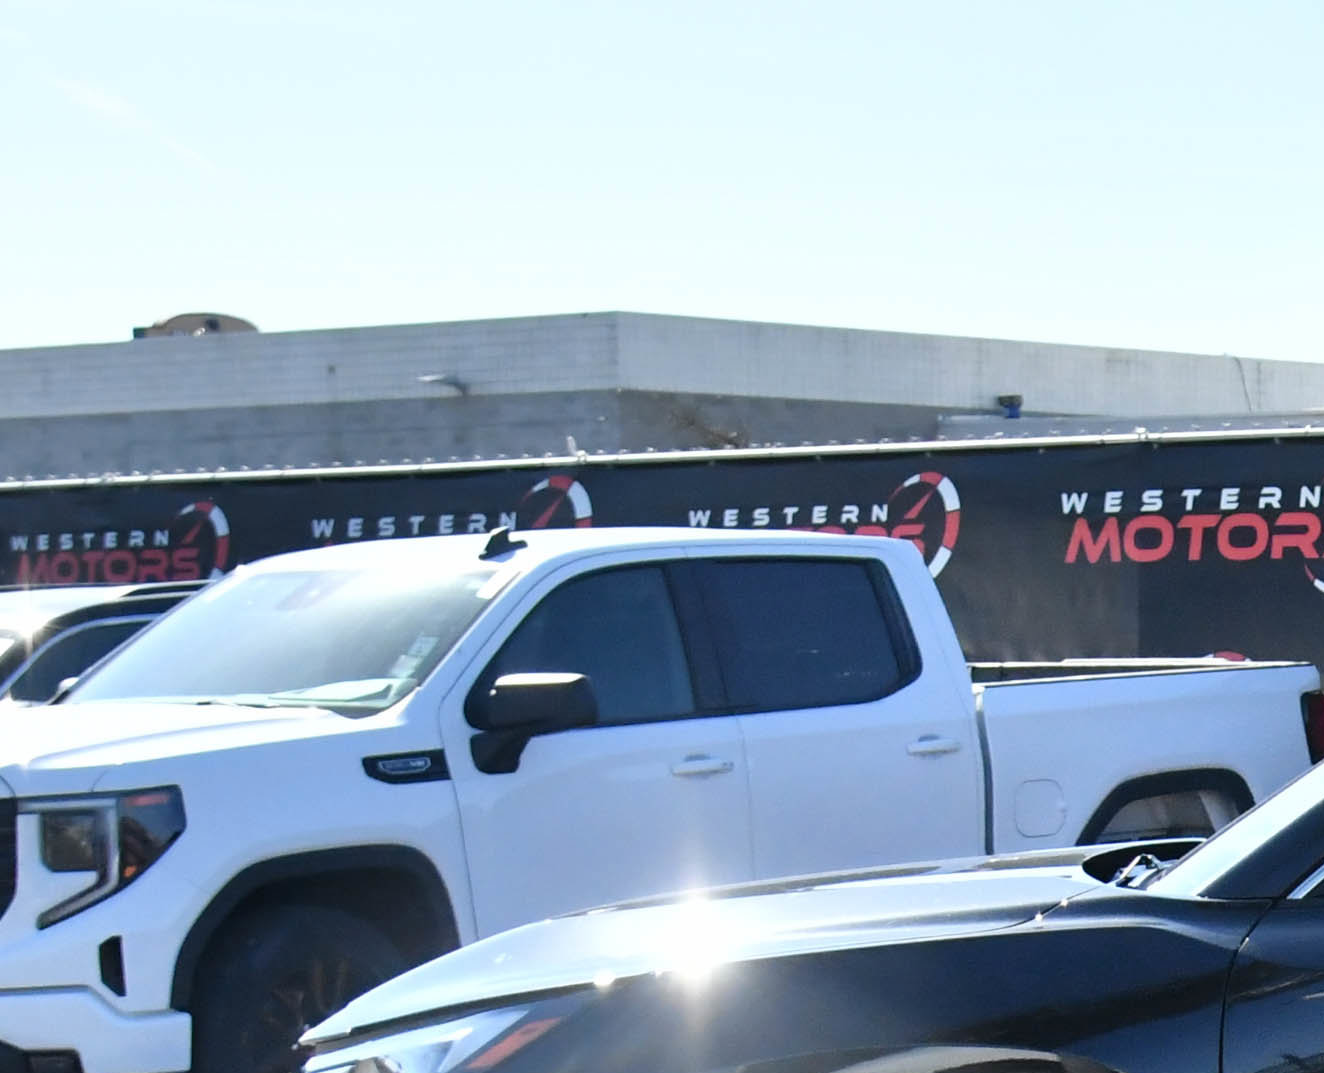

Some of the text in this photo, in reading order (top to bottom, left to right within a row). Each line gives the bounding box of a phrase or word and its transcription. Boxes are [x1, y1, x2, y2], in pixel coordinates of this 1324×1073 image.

[1060, 485, 1322, 515] WESTERN
[311, 511, 517, 538] WESTERN
[688, 503, 889, 527] WESTERN
[10, 529, 169, 550] WESTERN
[18, 548, 199, 584] MOTORS
